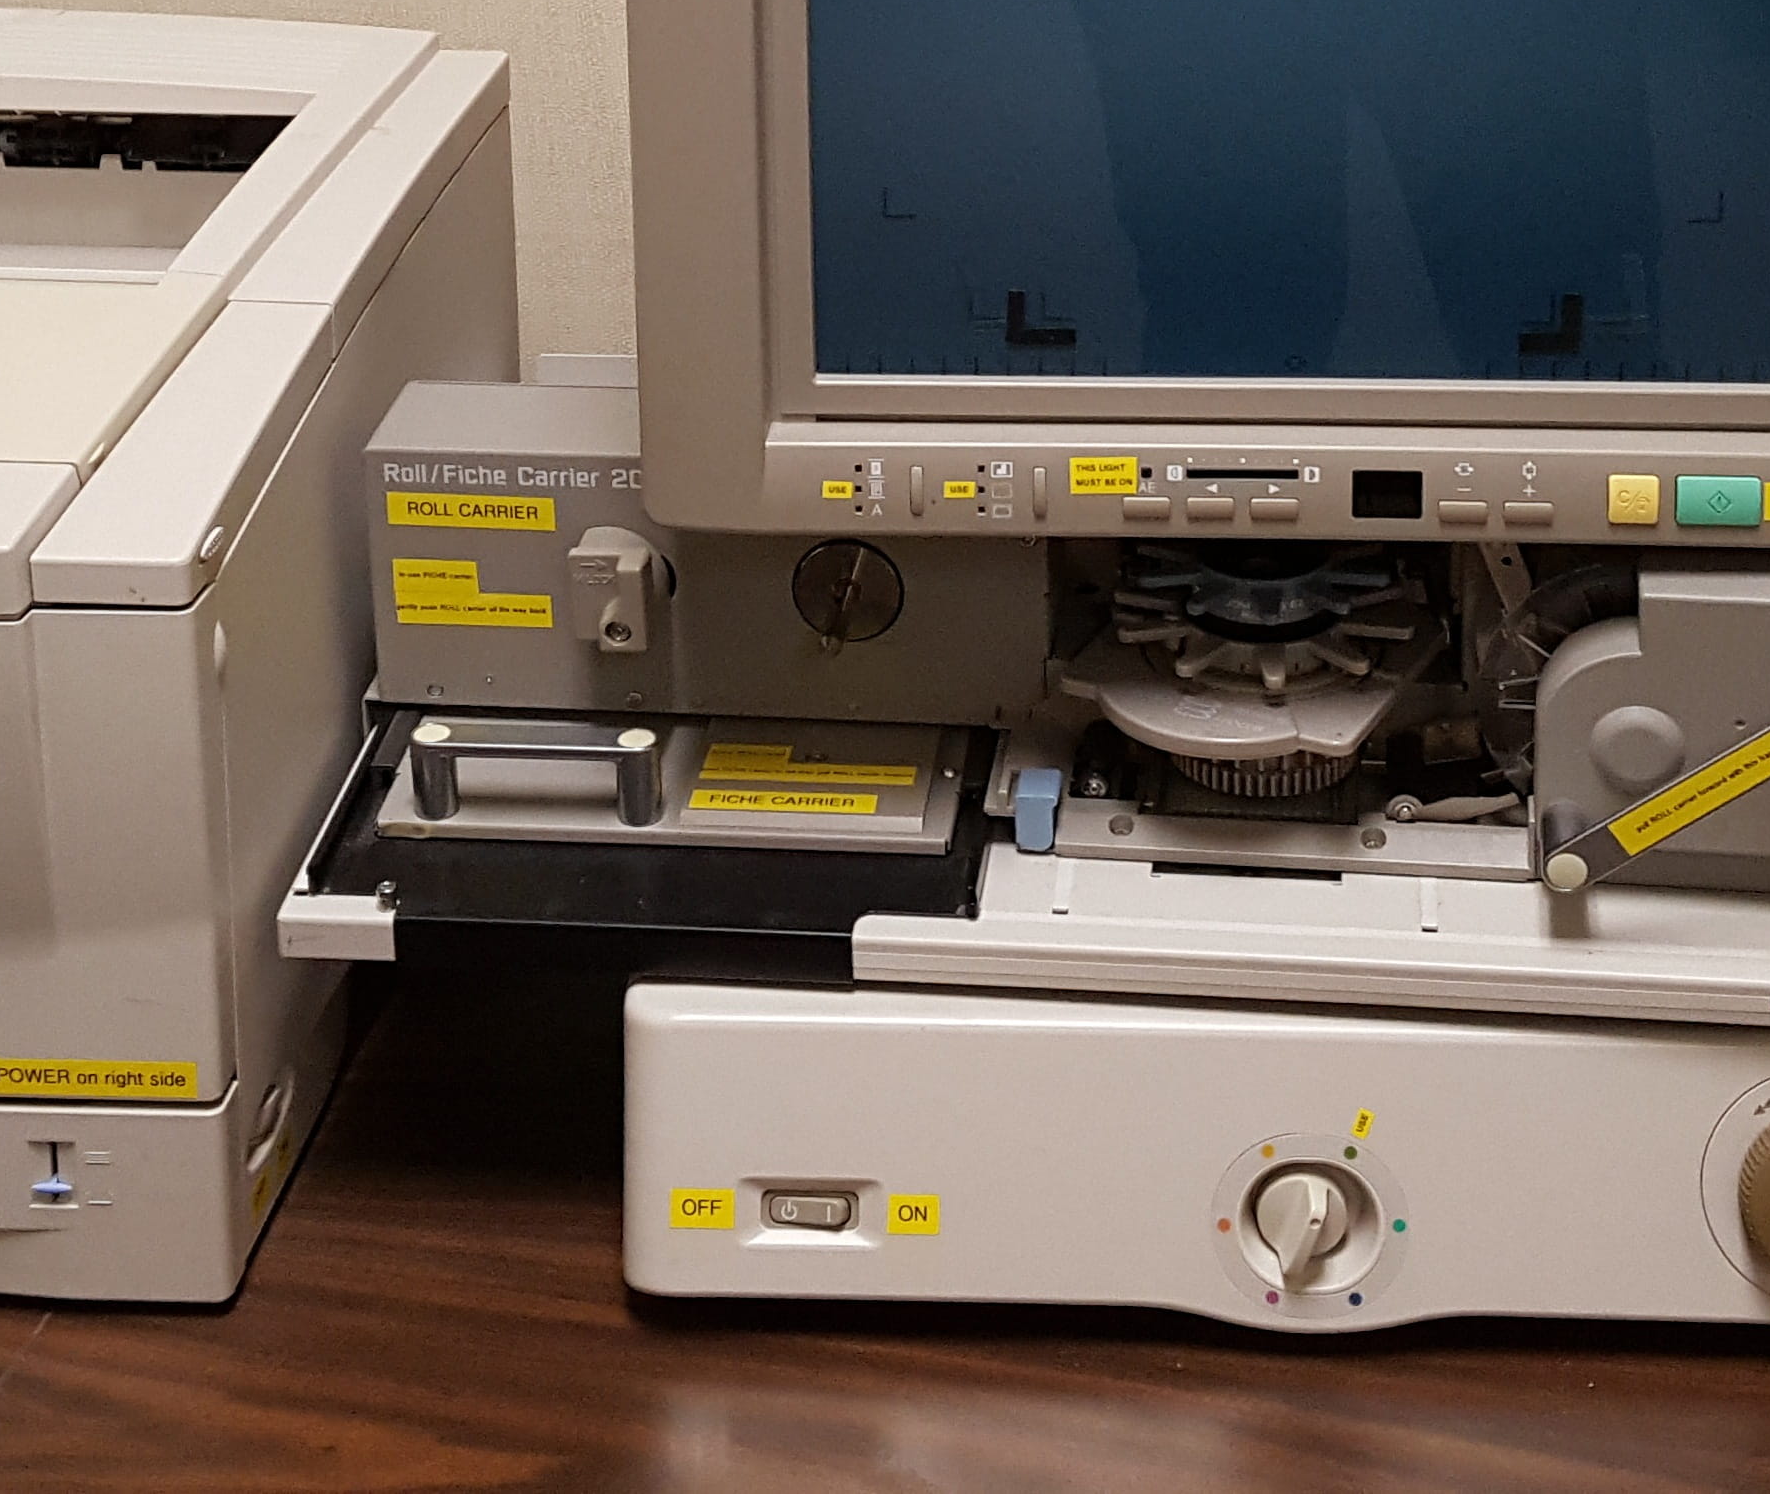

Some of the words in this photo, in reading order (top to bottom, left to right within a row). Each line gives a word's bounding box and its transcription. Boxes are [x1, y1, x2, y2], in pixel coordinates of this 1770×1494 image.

[1075, 464, 1096, 472] THIS
[1099, 464, 1125, 472] LIGHT
[383, 463, 507, 486] Roll/Fiche
[517, 466, 599, 488] Carrier
[1075, 478, 1101, 486] MUST
[1105, 478, 1116, 486] BE
[1119, 478, 1133, 486] ON
[829, 484, 847, 494] USE
[950, 484, 969, 495] USE
[1138, 482, 1157, 494] AE
[407, 501, 453, 517] ROLL
[458, 503, 539, 520] CARRIER
[709, 794, 763, 804] FICHE
[771, 796, 855, 806] CARRIER
[1650, 808, 1673, 824] ROLL
[77, 1072, 97, 1085] on
[105, 1070, 143, 1088] right
[150, 1070, 187, 1088] side
[682, 1198, 723, 1216] OFF
[898, 1204, 927, 1222] ON
